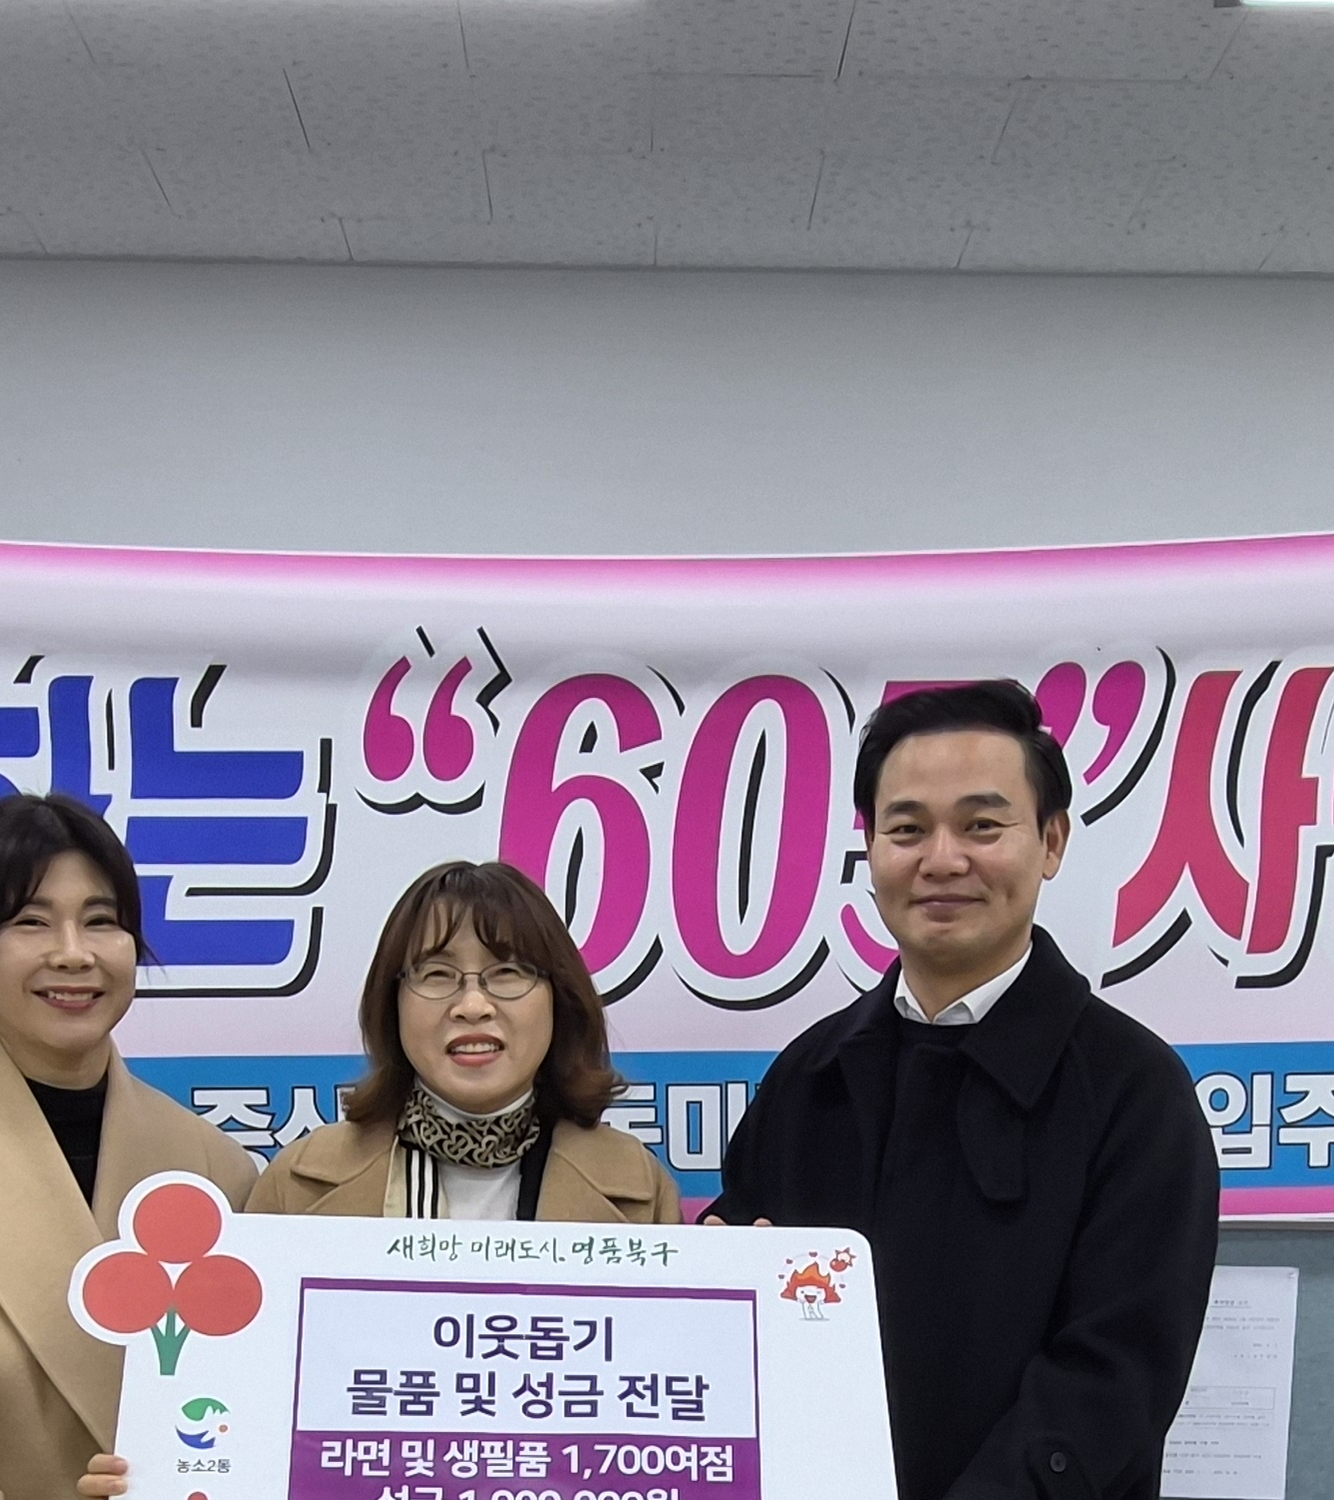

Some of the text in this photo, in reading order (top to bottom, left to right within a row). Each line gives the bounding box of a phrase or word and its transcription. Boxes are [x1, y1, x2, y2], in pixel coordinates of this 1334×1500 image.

[386, 1233, 462, 1262] 새희망
[571, 1235, 679, 1267] 명품북구
[433, 1314, 615, 1363] 이웃돕기
[347, 1368, 710, 1422] 물품 및 성금 전달
[176, 1458, 232, 1474] 농소2동
[320, 1438, 735, 1483] 라면 및 생필품 1,700여점
